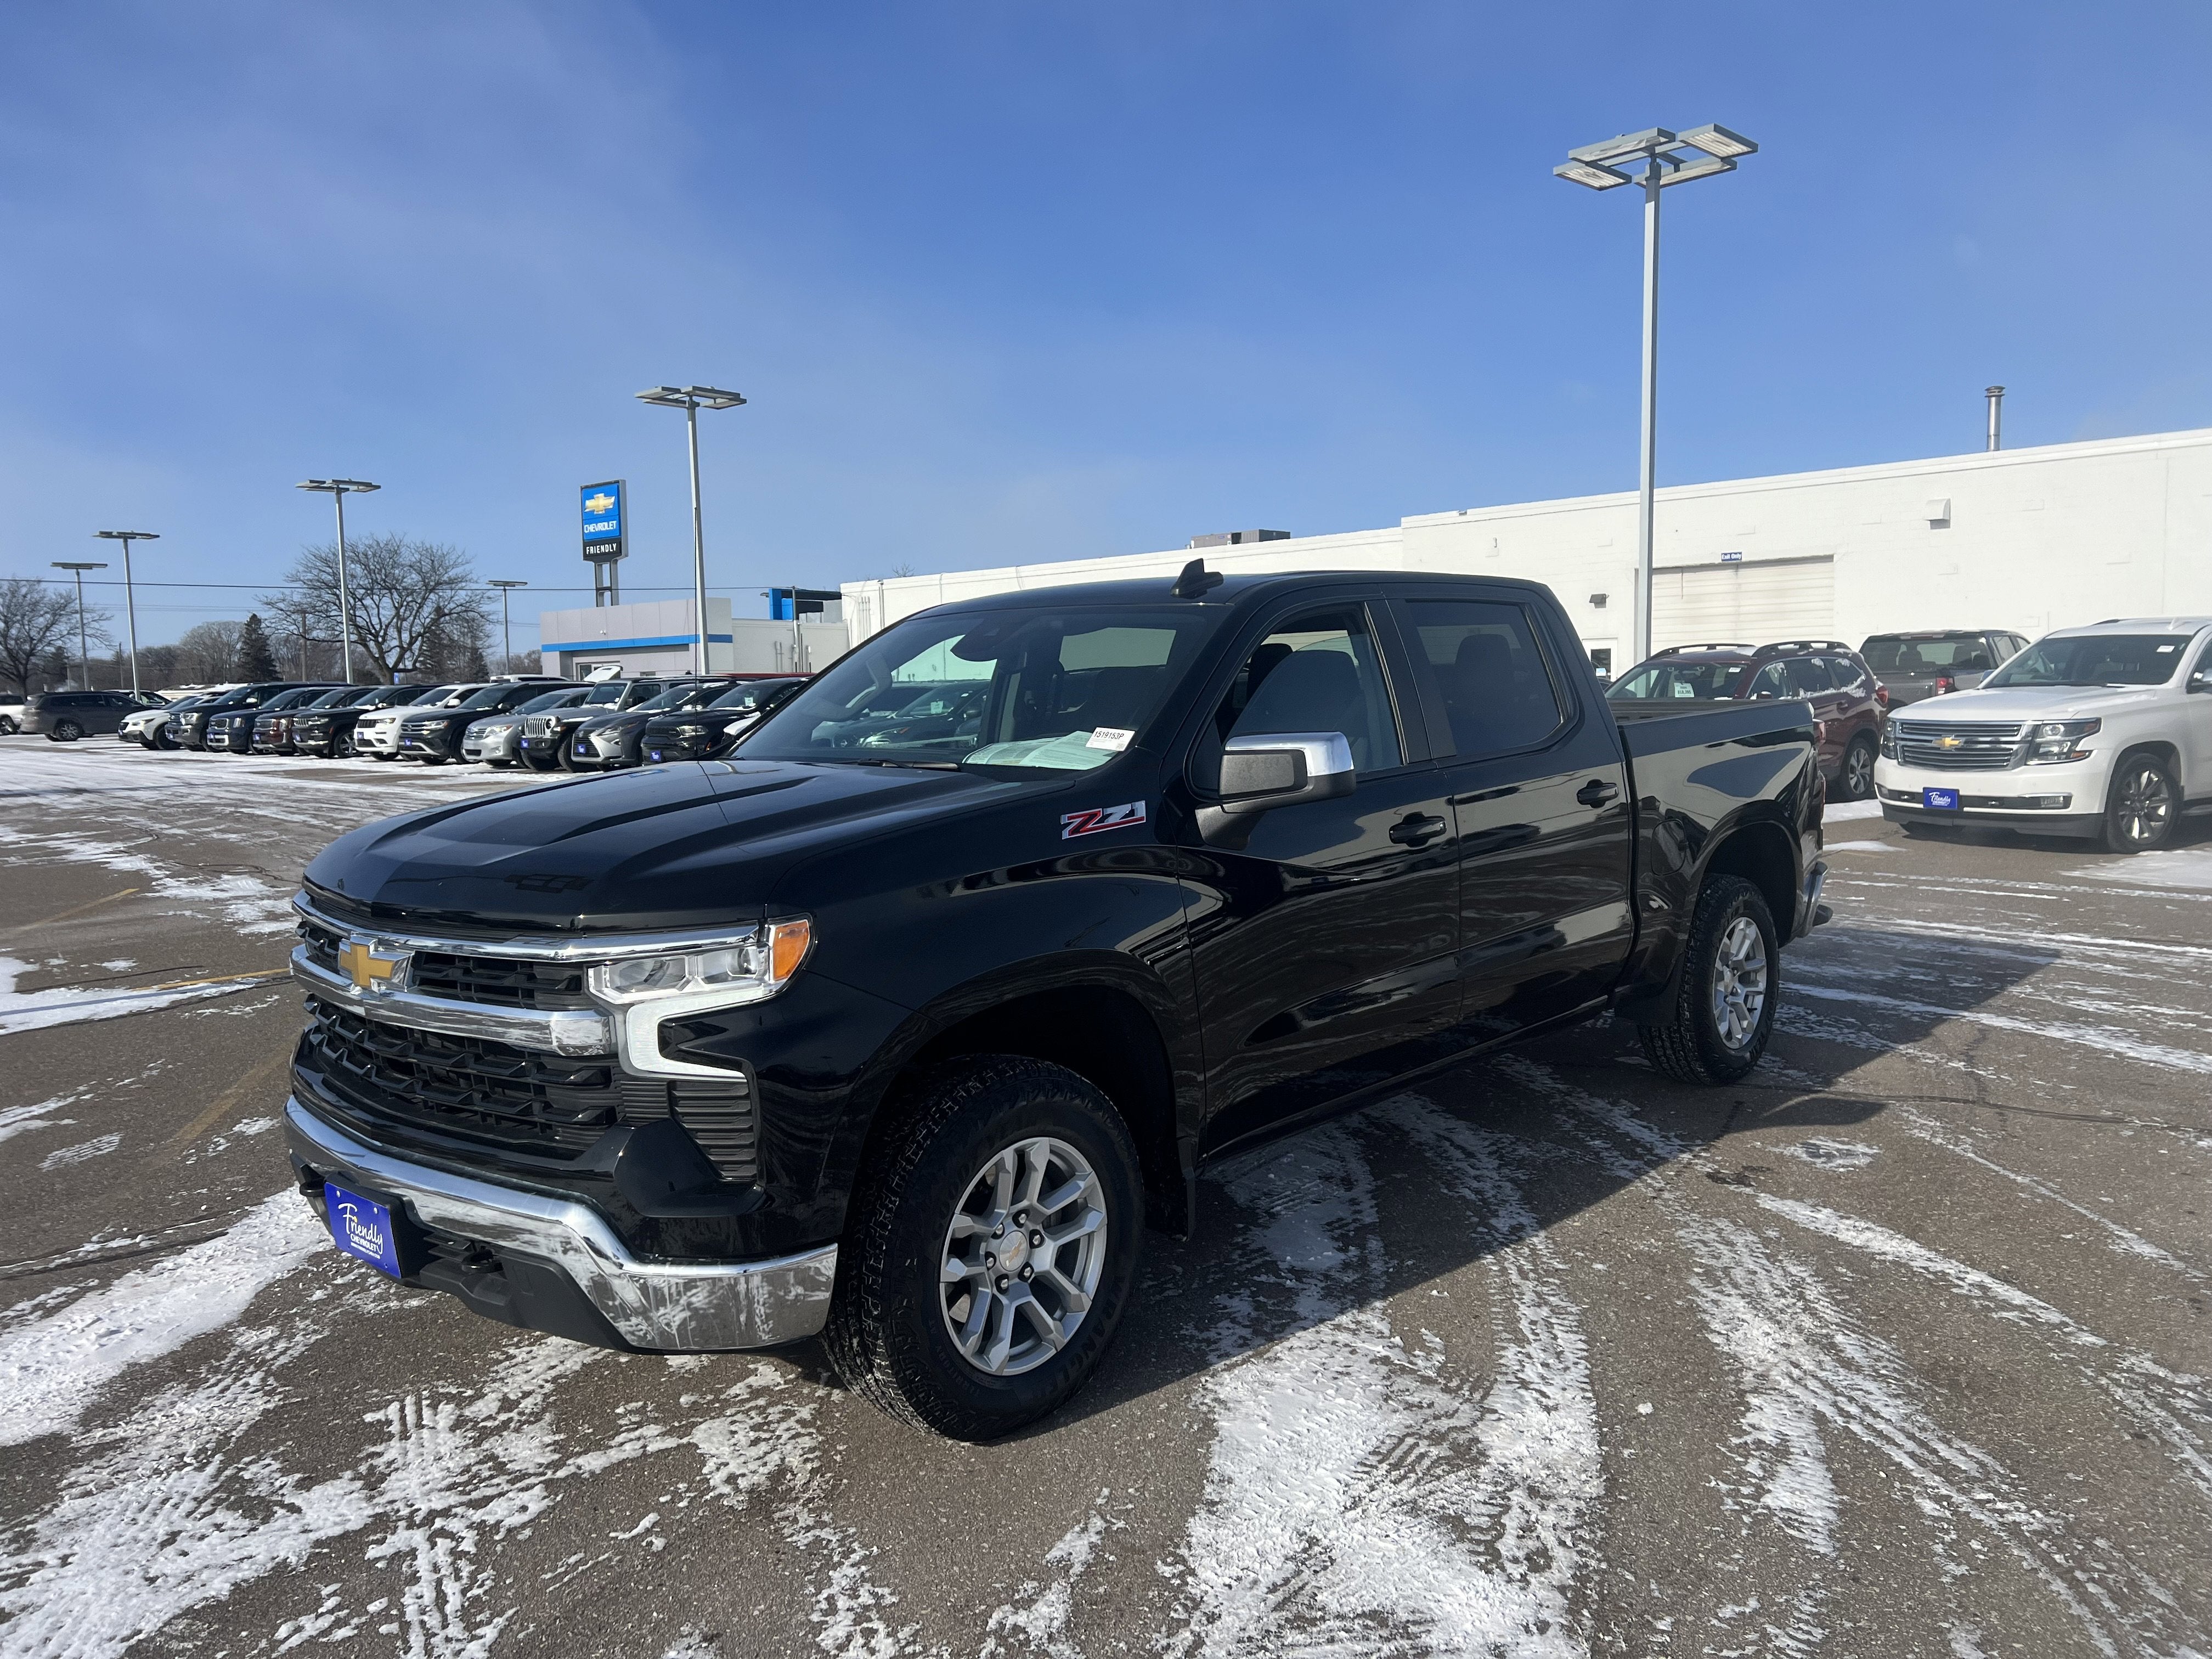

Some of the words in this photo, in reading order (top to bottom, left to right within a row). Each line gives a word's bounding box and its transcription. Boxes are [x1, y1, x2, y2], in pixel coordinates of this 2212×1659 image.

[584, 521, 617, 533] CHEVROLET
[586, 543, 617, 555] FRIENDLY
[1094, 731, 1125, 740] 1519153P
[1928, 791, 1951, 805] Friendly
[1060, 800, 1146, 840] Z71
[338, 1203, 383, 1255] Friendly
[350, 1233, 376, 1252] CHEVROLET
